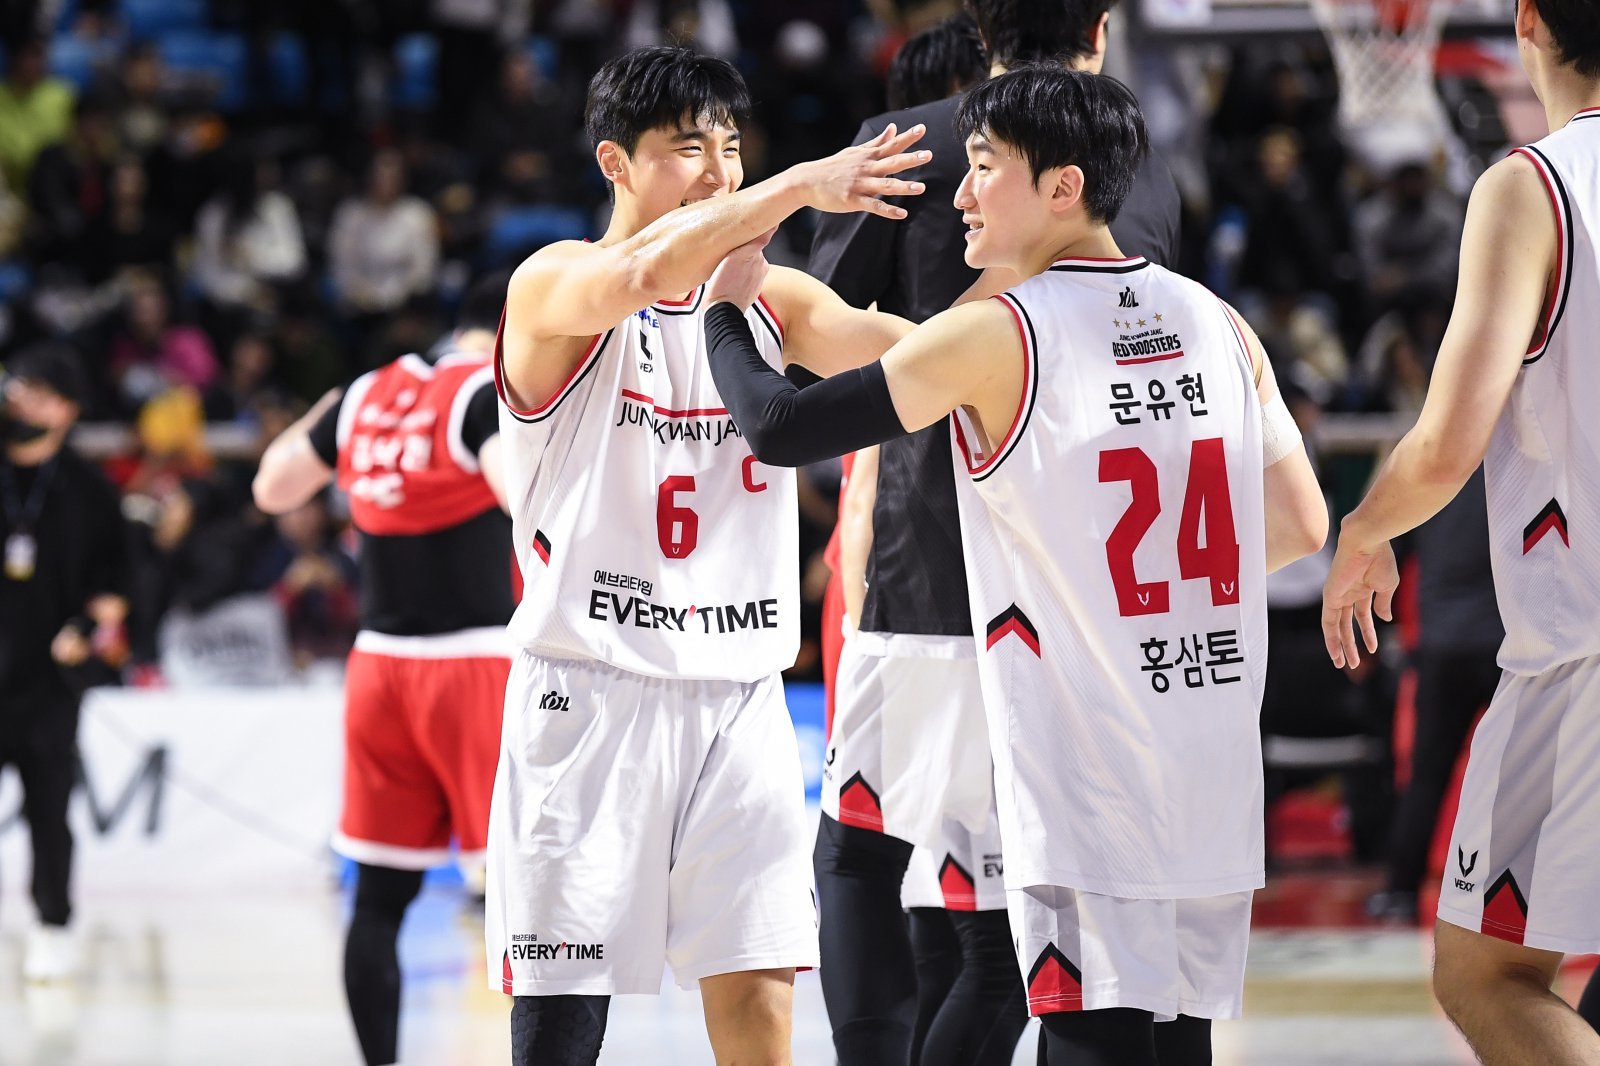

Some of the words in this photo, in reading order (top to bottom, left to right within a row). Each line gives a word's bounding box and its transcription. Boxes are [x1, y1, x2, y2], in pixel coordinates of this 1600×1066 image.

[1112, 341, 1130, 358] RED
[1128, 334, 1181, 355] BOOSTERS
[1150, 328, 1163, 336] JANG
[1109, 372, 1208, 426] 문유현
[616, 402, 654, 430] JUN
[741, 454, 768, 493] C
[656, 474, 699, 560] 6
[1098, 436, 1240, 617] 24
[593, 569, 653, 597] 에브리타임
[1139, 629, 1245, 694] 홍삼톤
[1454, 877, 1475, 893] VEXX
